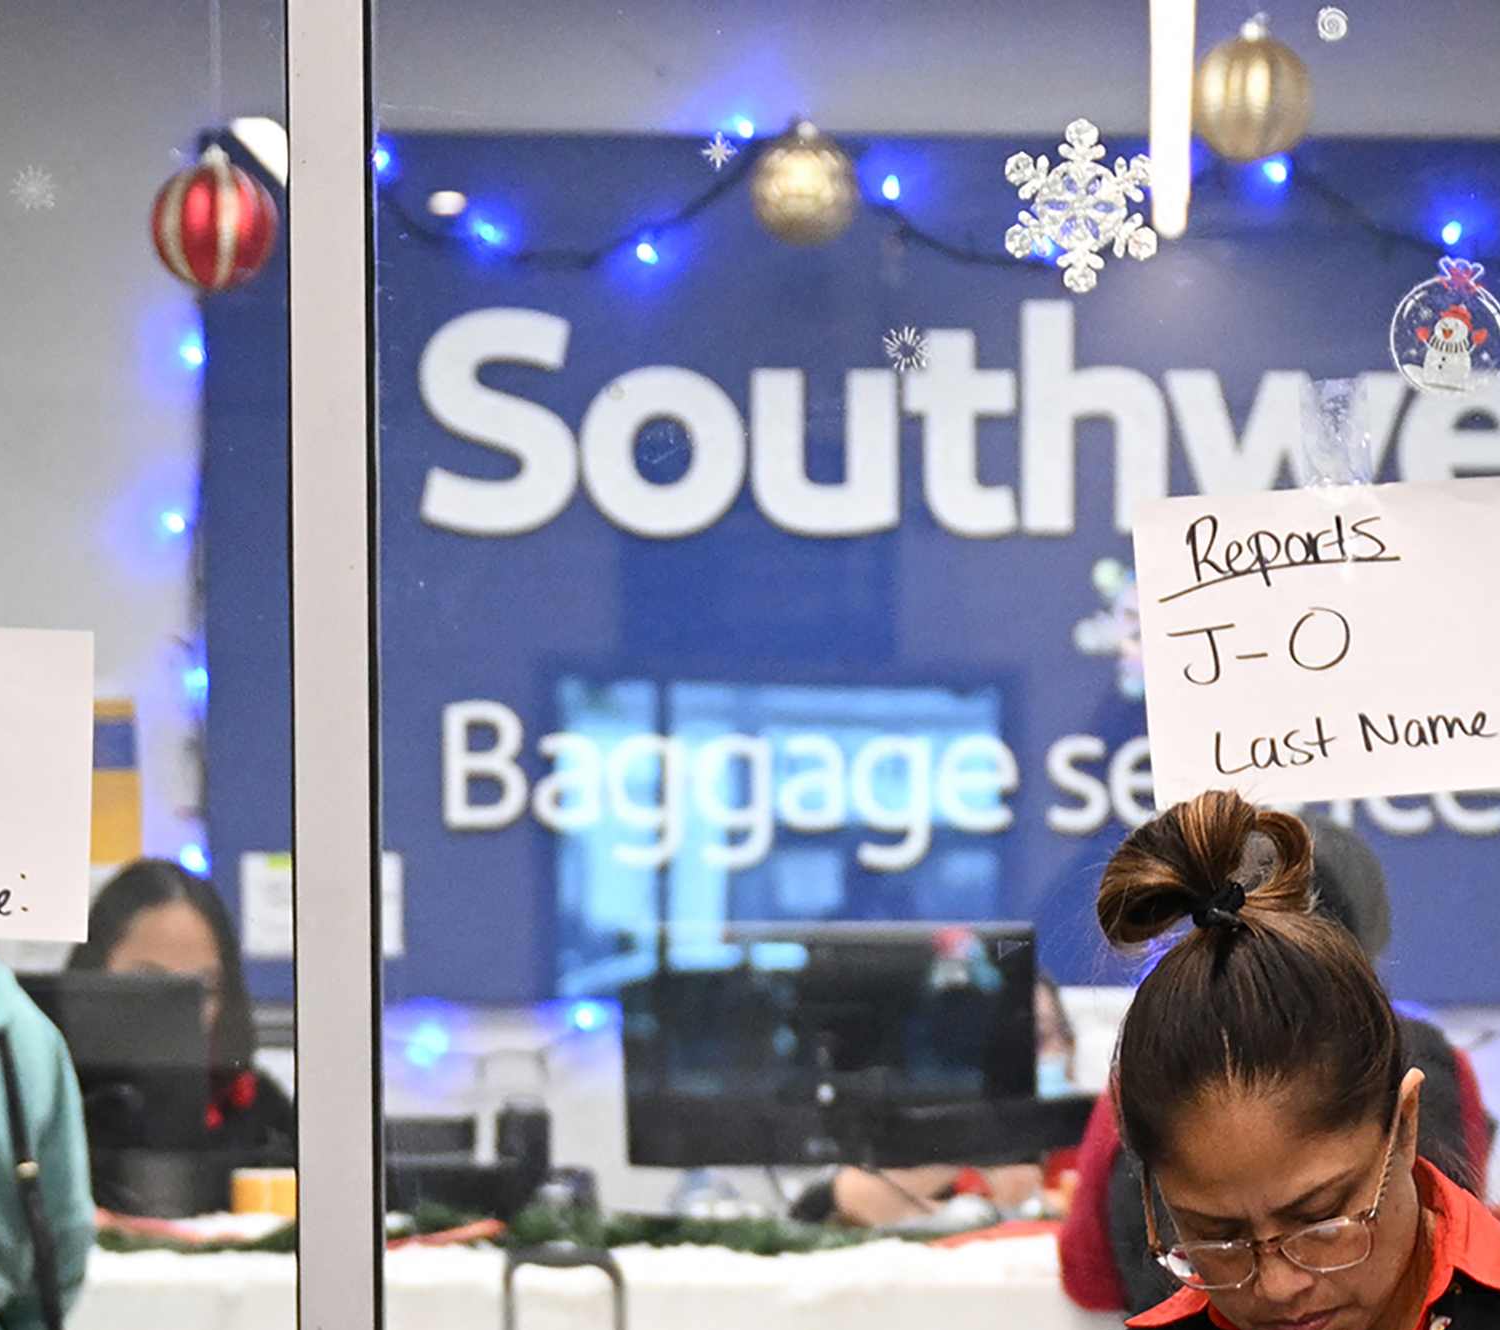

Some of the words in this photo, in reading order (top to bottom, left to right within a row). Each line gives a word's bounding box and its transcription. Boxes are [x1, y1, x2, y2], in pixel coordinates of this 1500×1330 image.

[1186, 514, 1388, 587] Reports
[1214, 717, 1336, 775] Last
[1361, 710, 1499, 753] Name
[443, 702, 1011, 872] Baggage
